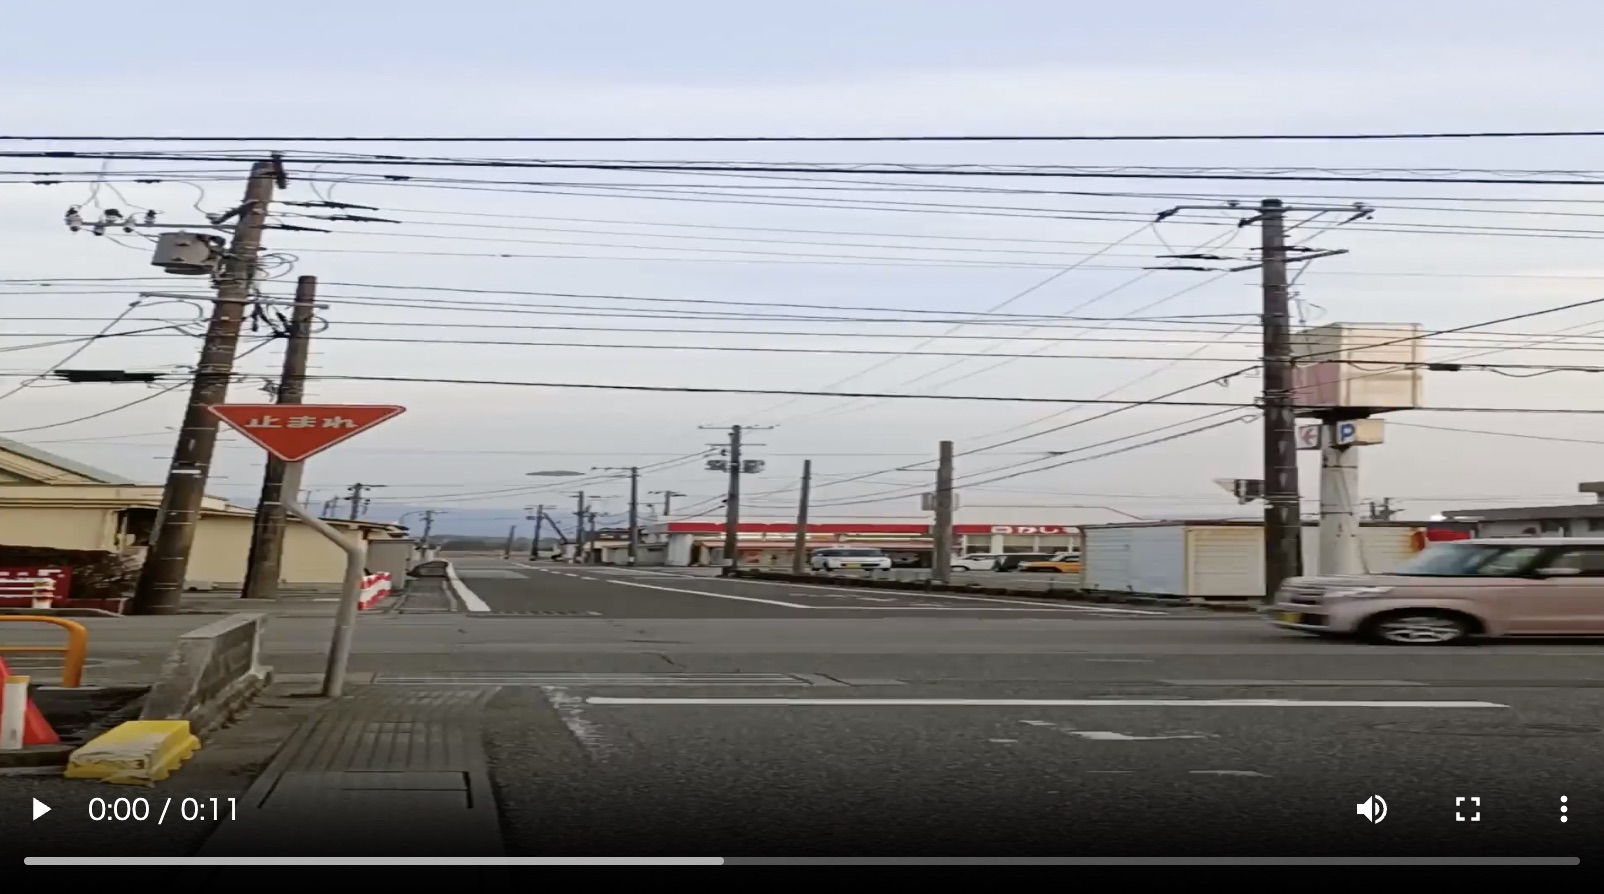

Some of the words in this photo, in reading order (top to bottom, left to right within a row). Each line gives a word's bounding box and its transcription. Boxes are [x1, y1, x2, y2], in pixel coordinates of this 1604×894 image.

[244, 415, 358, 428] 止まれ
[1340, 423, 1356, 442] P
